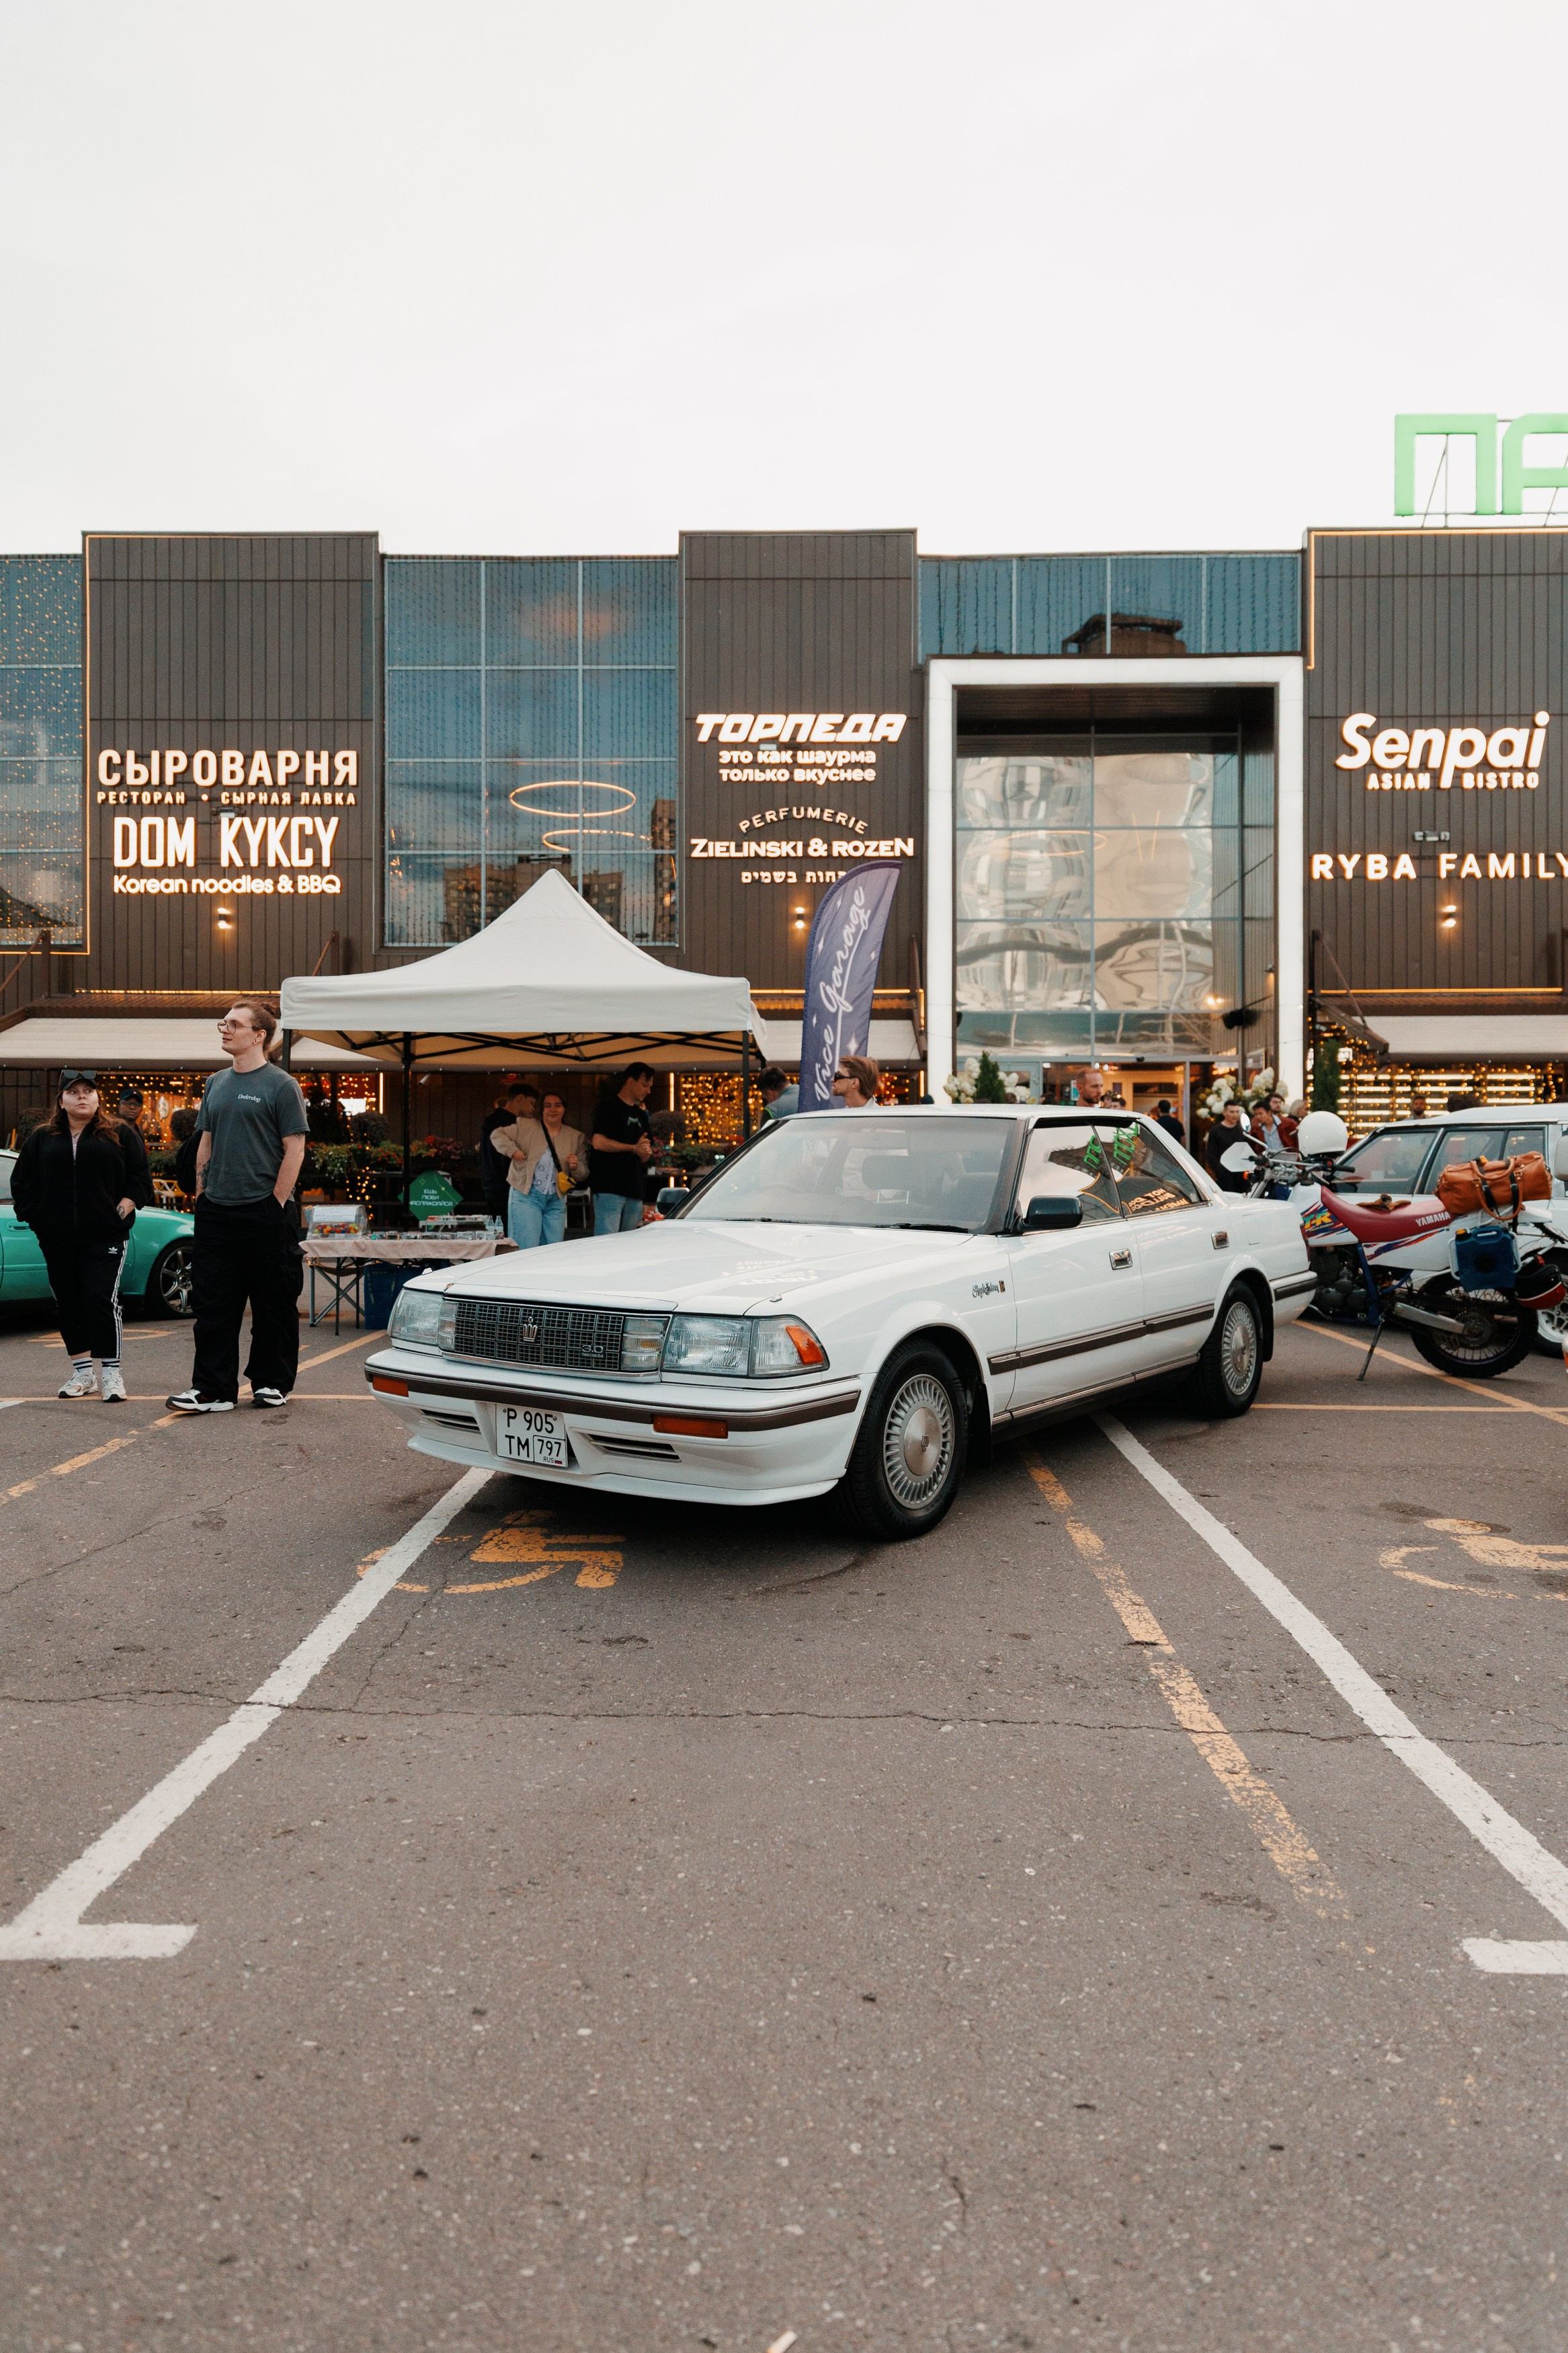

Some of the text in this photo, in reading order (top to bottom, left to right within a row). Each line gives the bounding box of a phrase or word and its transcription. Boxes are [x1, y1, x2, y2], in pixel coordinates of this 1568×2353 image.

[695, 713, 907, 743] ТОРПЕДА
[718, 750, 876, 766] это как шаурма
[1335, 711, 1551, 790] Senpai
[98, 749, 358, 787] СЫРОВАРНЯ
[718, 768, 876, 785] только вкуснее
[1367, 771, 1539, 790] ASIAN BISTRO
[97, 791, 356, 805] РЕСТОРАН СЫРНАЯ ЛАВКА
[738, 806, 868, 834] PERFUMERIE
[114, 817, 195, 868] DOM
[808, 838, 827, 856] &
[1313, 852, 1568, 880] RYBA FAMILY
[114, 875, 341, 893] Korean noodles & BBQ
[741, 871, 798, 883] בשמים
[819, 885, 871, 1013] Garage
[238, 1094, 261, 1103] Underdog
[1415, 1211, 1451, 1227] YAMAHA
[582, 1345, 604, 1353] 3.0
[524, 1410, 554, 1433] 905
[537, 1439, 561, 1457] 797
